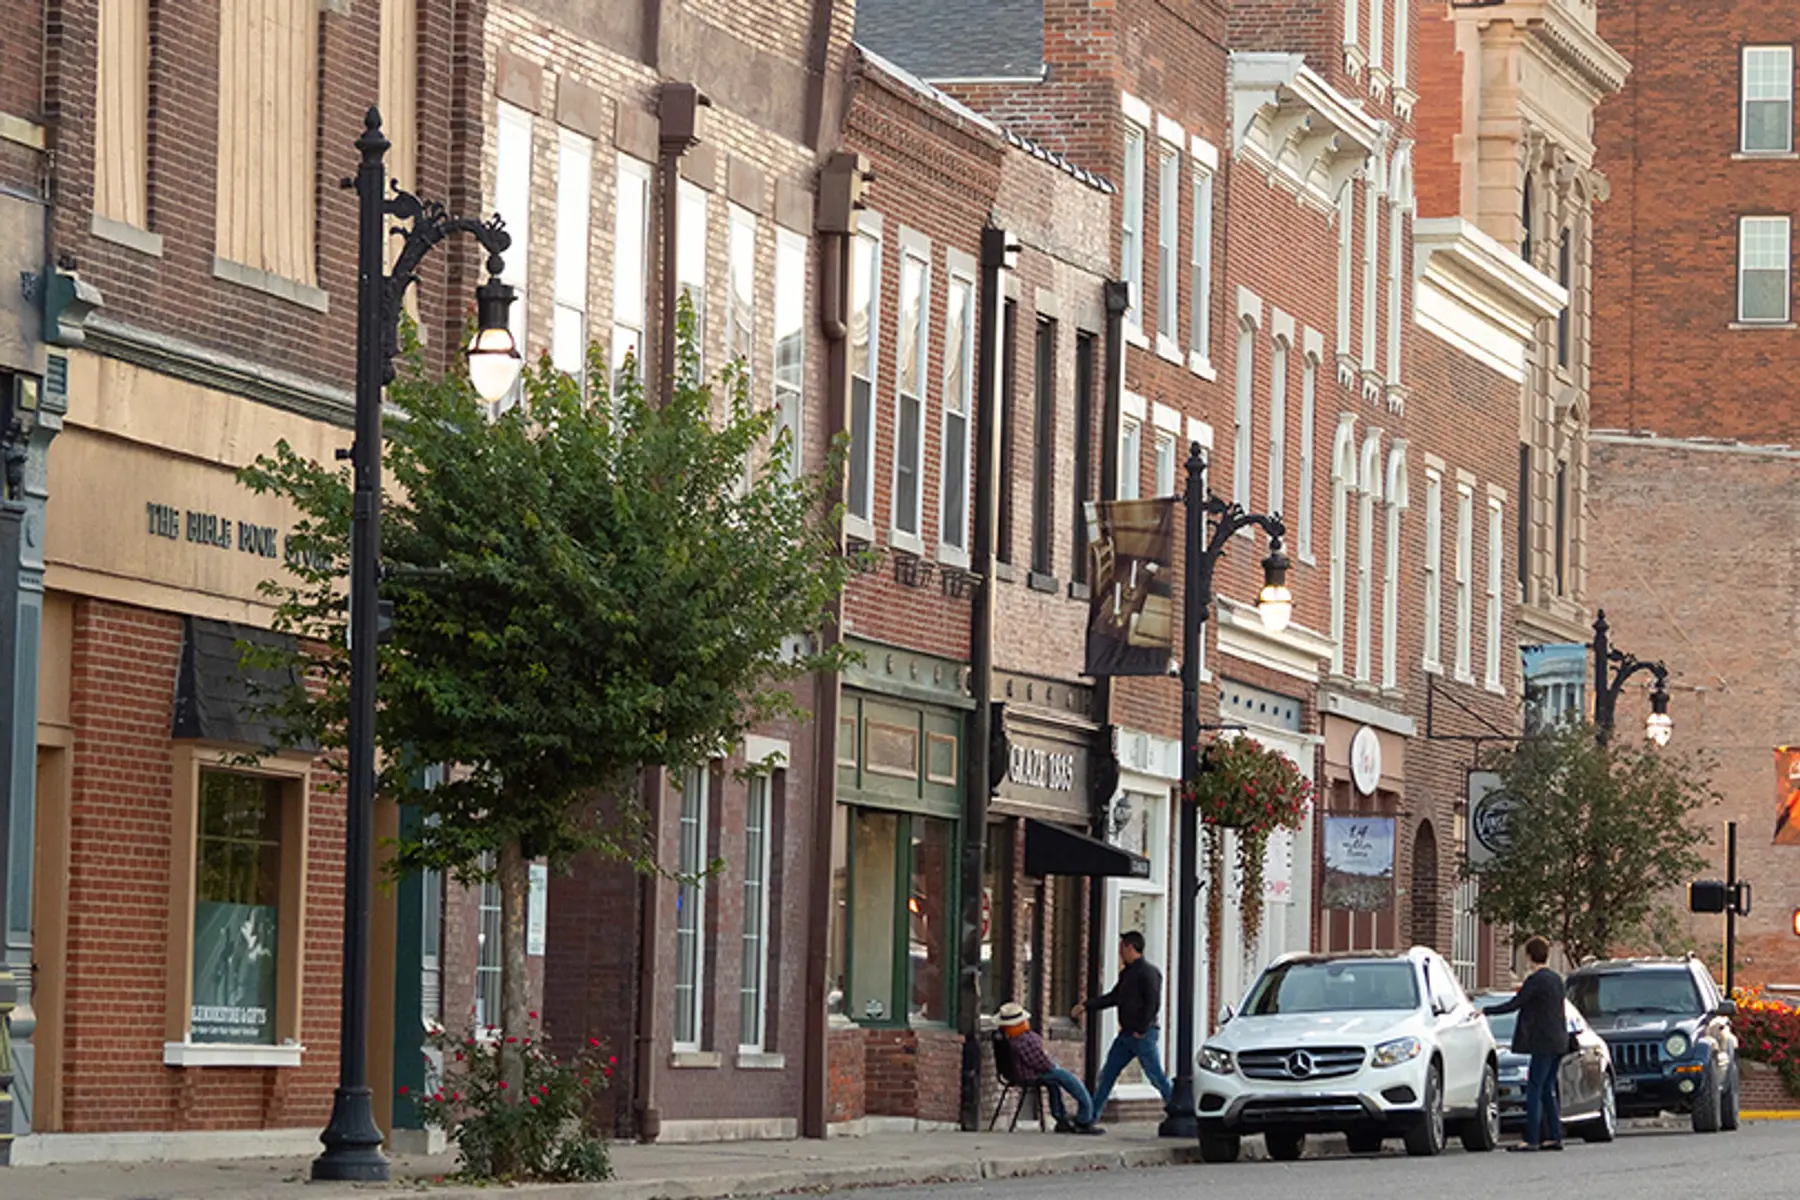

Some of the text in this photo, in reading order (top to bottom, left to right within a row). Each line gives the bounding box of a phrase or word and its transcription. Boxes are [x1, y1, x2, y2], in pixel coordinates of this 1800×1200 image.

[147, 502, 179, 540] THE
[186, 510, 232, 549] BIBLE
[238, 520, 278, 559] BOOK
